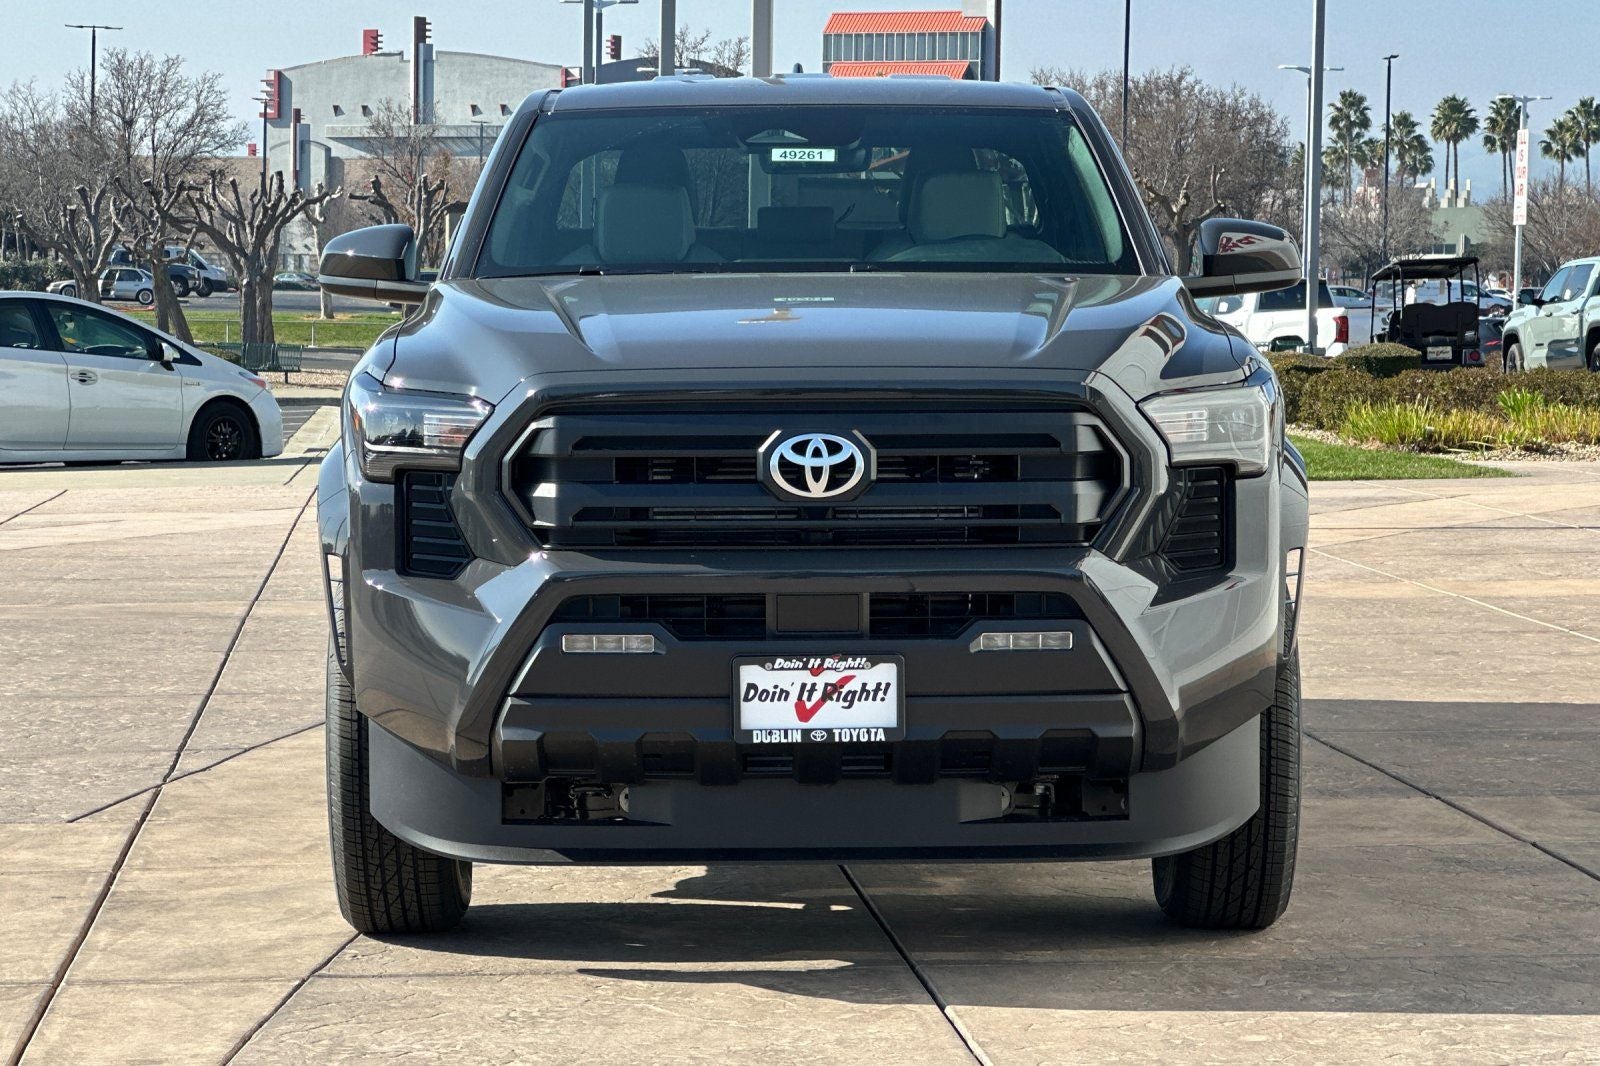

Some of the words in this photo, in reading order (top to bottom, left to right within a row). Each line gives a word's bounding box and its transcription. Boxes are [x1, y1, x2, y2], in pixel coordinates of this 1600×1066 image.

[779, 150, 823, 160] 49261
[774, 658, 806, 669] Doin'
[808, 658, 821, 669] It
[824, 658, 867, 672] Right!
[742, 682, 794, 702] Doin'
[797, 682, 817, 702] It
[821, 682, 891, 709] Right!
[753, 729, 802, 743] DUBLIN
[832, 728, 885, 742] TOYOTA
